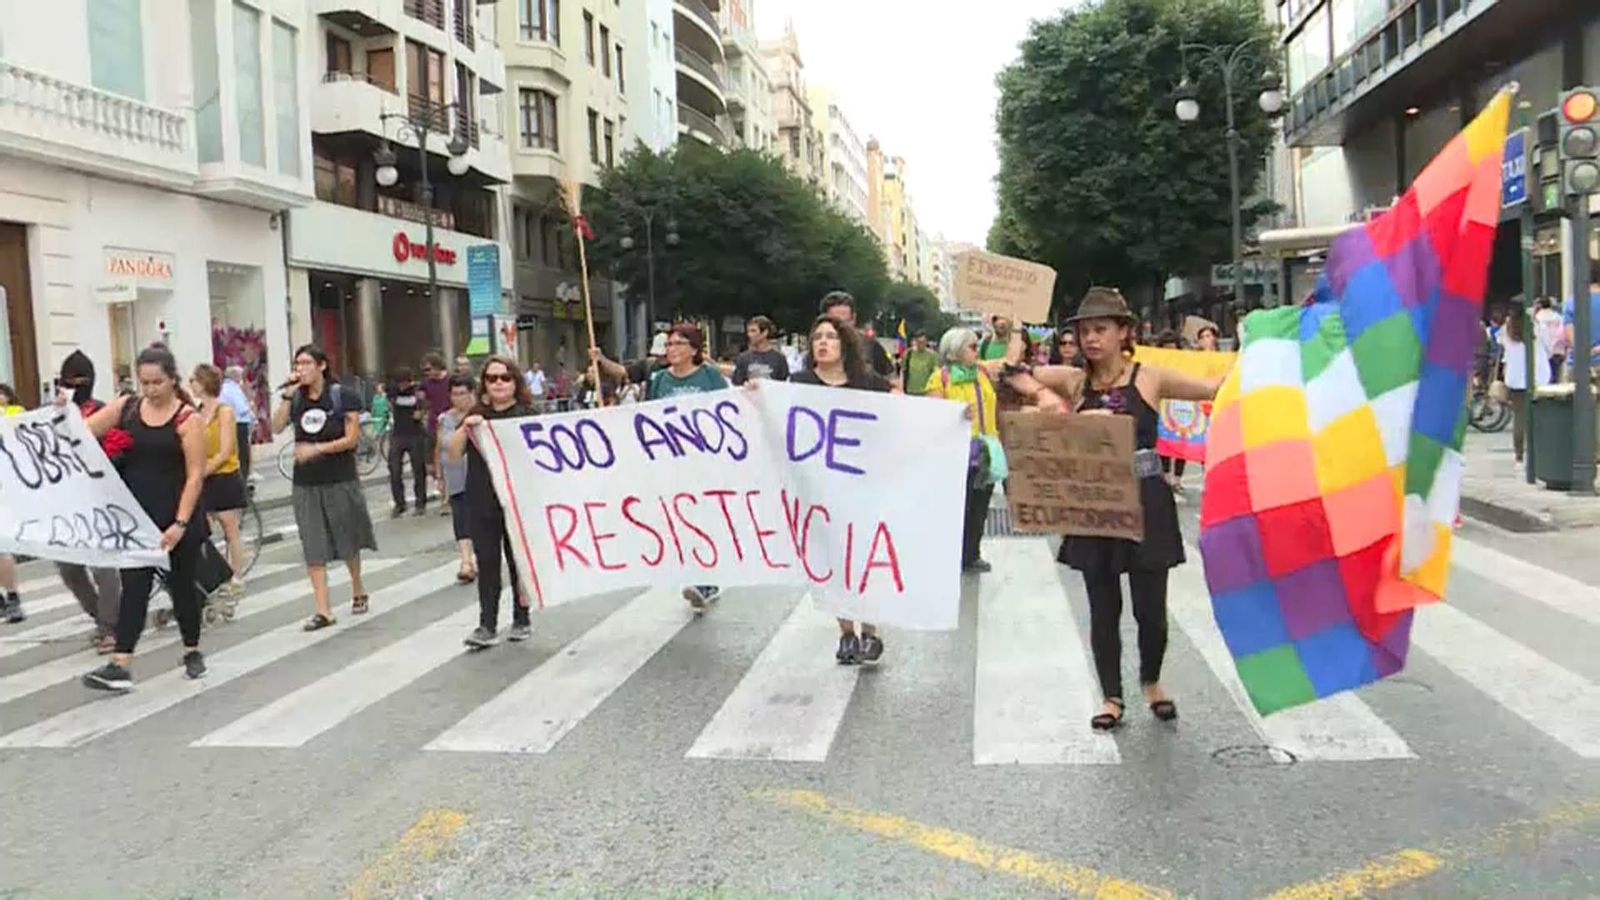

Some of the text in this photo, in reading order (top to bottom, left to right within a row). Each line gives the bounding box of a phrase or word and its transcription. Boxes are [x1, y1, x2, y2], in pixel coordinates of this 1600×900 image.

[1502, 154, 1525, 181] TAXI
[107, 256, 174, 277] PANDORA
[520, 401, 878, 474] 500 AÑOS DE
[546, 490, 904, 594] RESISTENCIA
